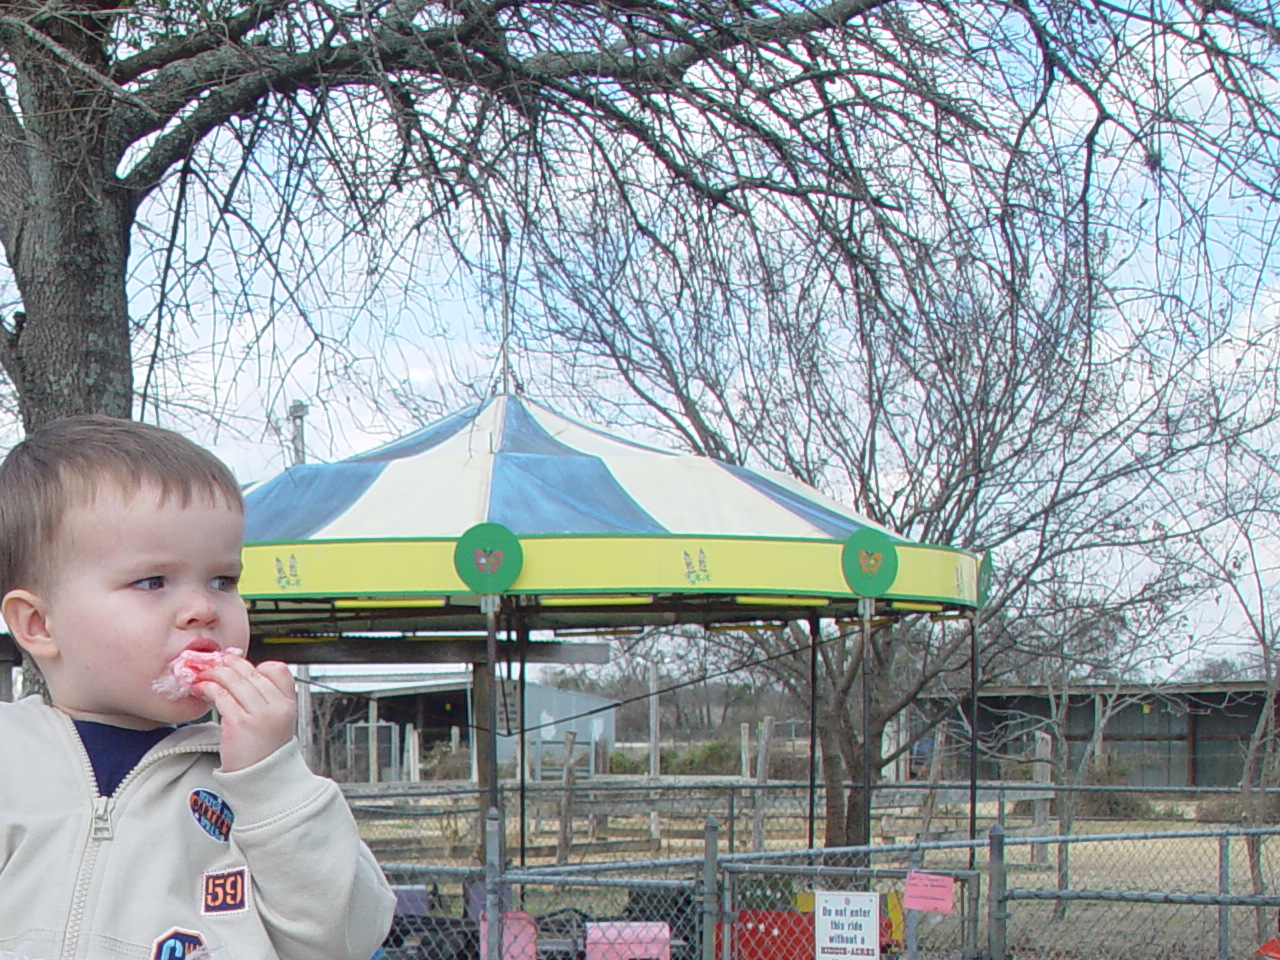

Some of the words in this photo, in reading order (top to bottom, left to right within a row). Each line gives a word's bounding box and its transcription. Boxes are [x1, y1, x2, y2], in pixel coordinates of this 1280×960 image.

[206, 874, 243, 907] 59
[822, 906, 832, 917] Do
[834, 907, 847, 917] not
[850, 907, 871, 918] enter
[830, 920, 845, 931] this
[847, 920, 863, 931] ride
[828, 933, 857, 945] without
[860, 936, 865, 945] a
